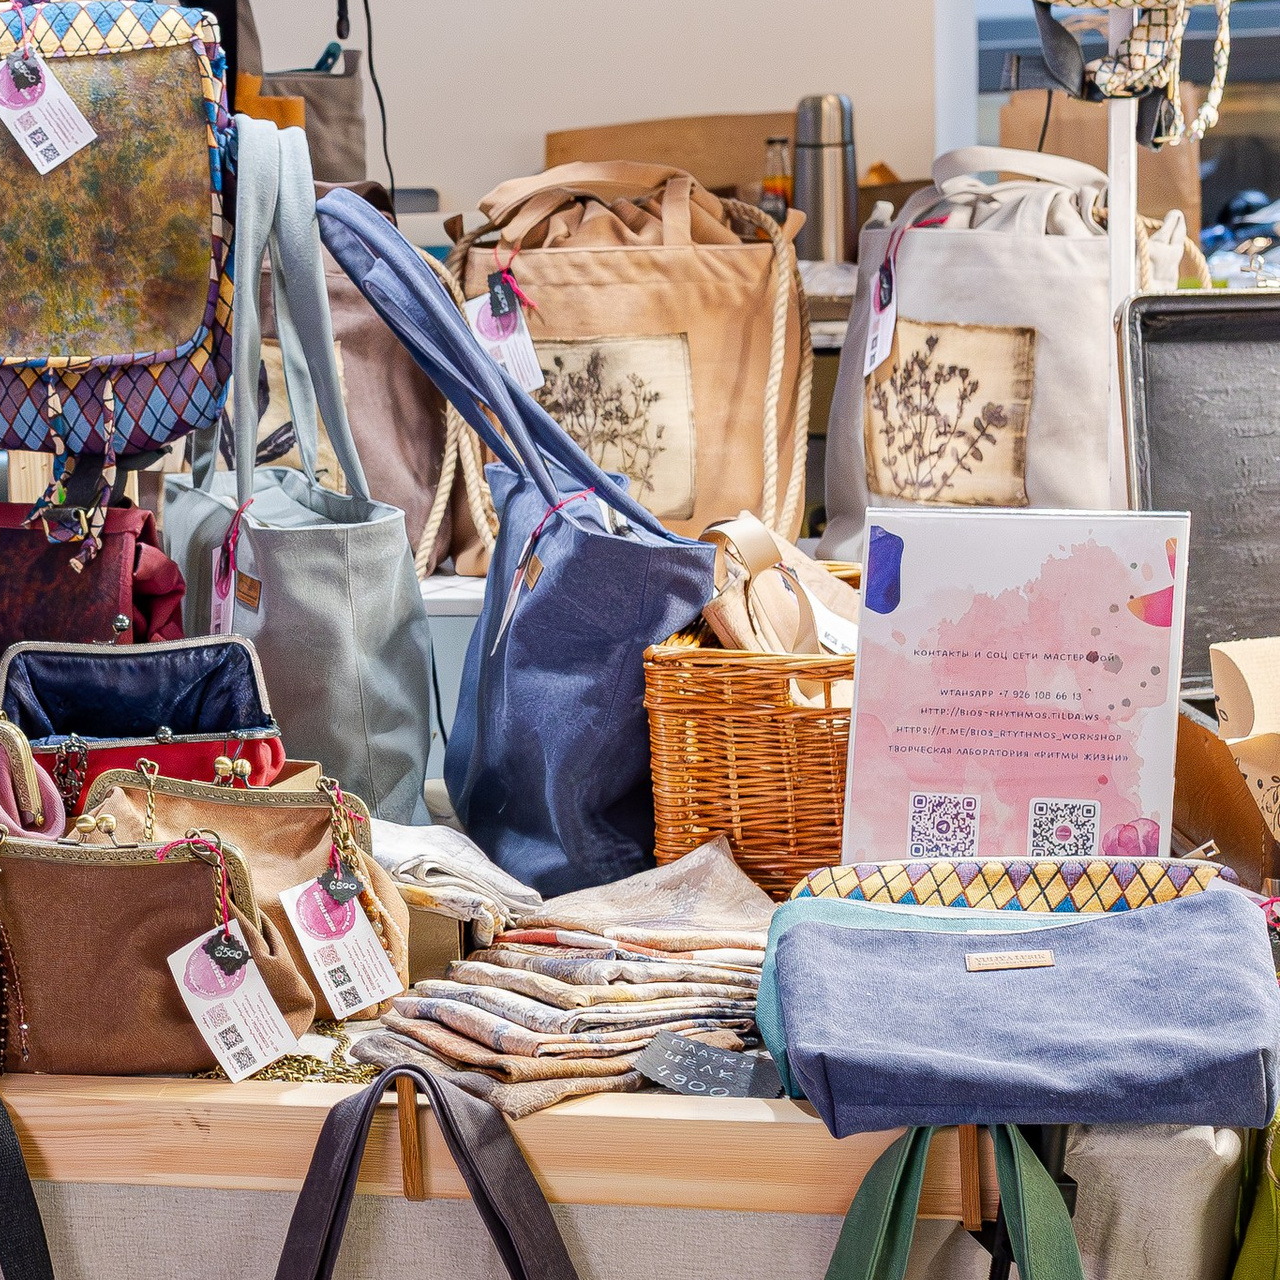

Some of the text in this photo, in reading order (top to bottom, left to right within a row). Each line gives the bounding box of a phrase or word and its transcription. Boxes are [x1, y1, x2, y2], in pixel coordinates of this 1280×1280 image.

[913, 649, 969, 658] КОНТАКТЫ
[986, 651, 1008, 660] СОЦ
[1012, 651, 1038, 660] СЕТИ
[1043, 652, 1115, 662] МАСТЕРОЙ
[1013, 690, 1031, 699] 926
[1034, 691, 1051, 700] 108
[1055, 692, 1068, 700] 66
[1072, 692, 1082, 701] 13
[888, 745, 952, 755] ТВОРЧЕСКАЯ
[956, 747, 1029, 758] ЛАБОРАТОРИЯ
[671, 1038, 755, 1070] ПЛАТКИ
[657, 1065, 730, 1097] 4900
